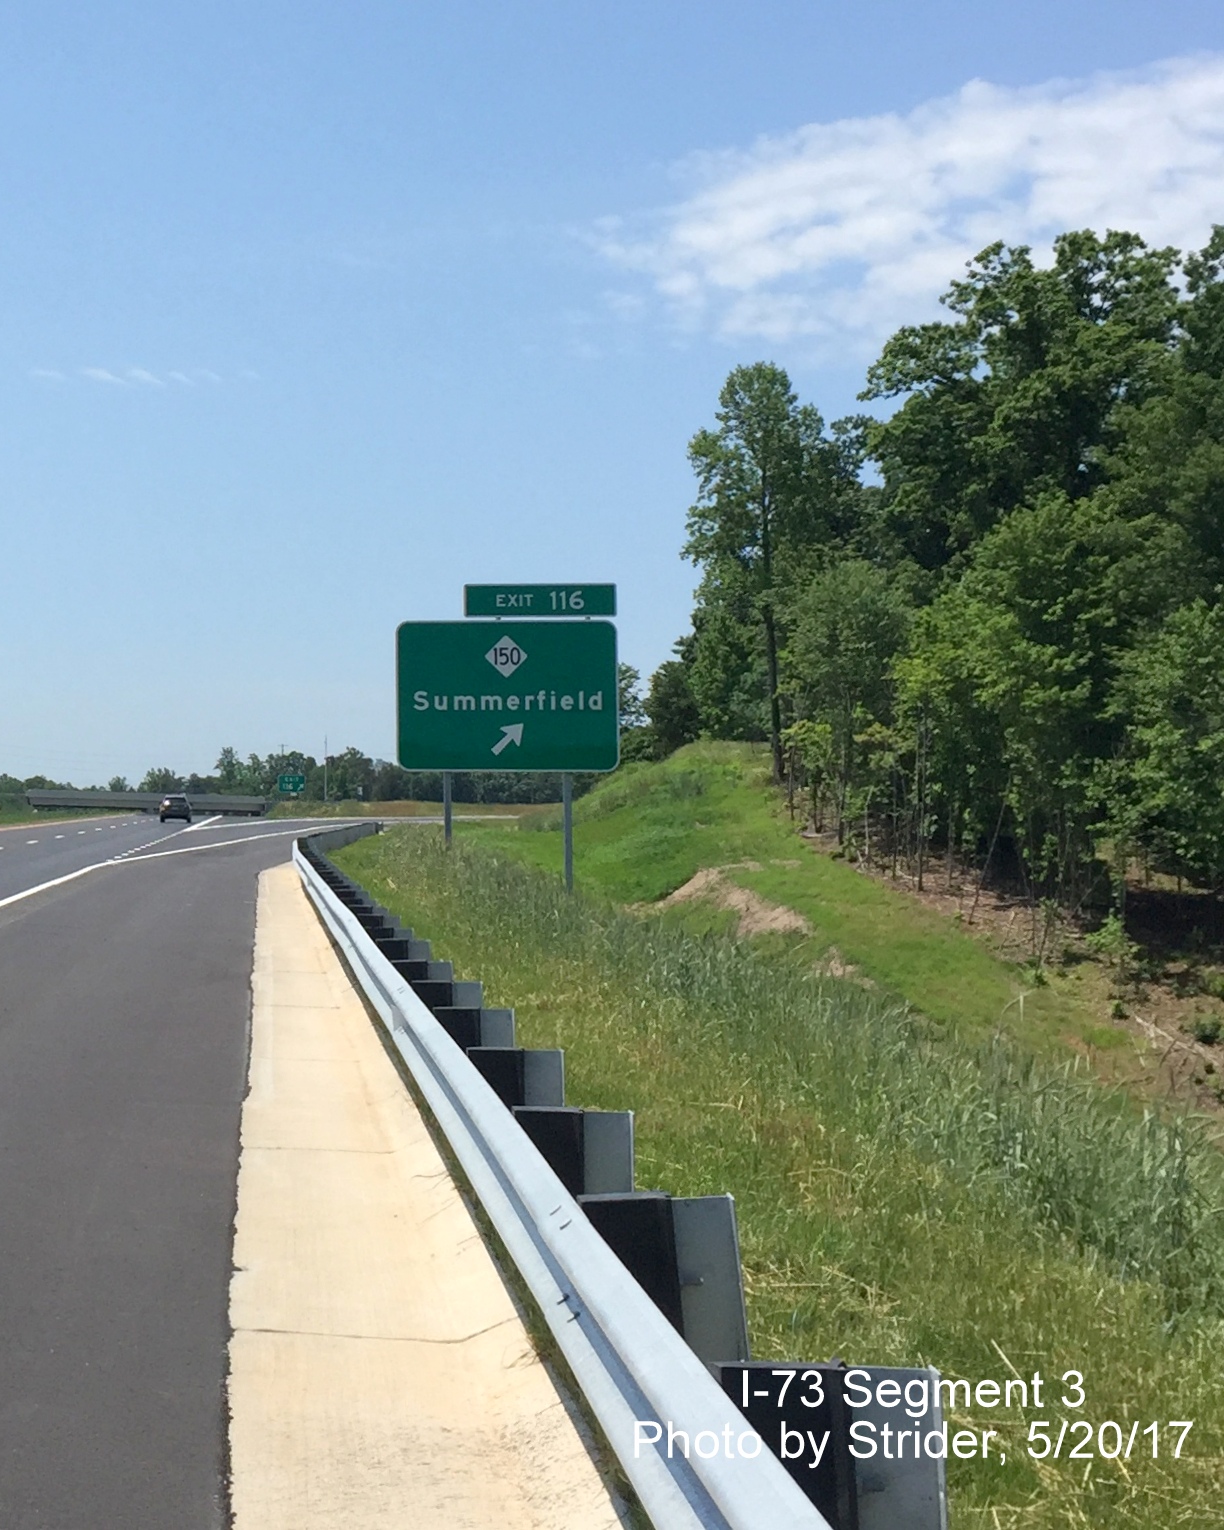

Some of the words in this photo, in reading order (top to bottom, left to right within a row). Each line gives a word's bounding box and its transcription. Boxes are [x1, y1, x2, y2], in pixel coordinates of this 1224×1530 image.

[496, 594, 534, 608] EXIT
[549, 590, 585, 610] 116
[493, 646, 521, 666] 150
[413, 690, 603, 711] Summerfield
